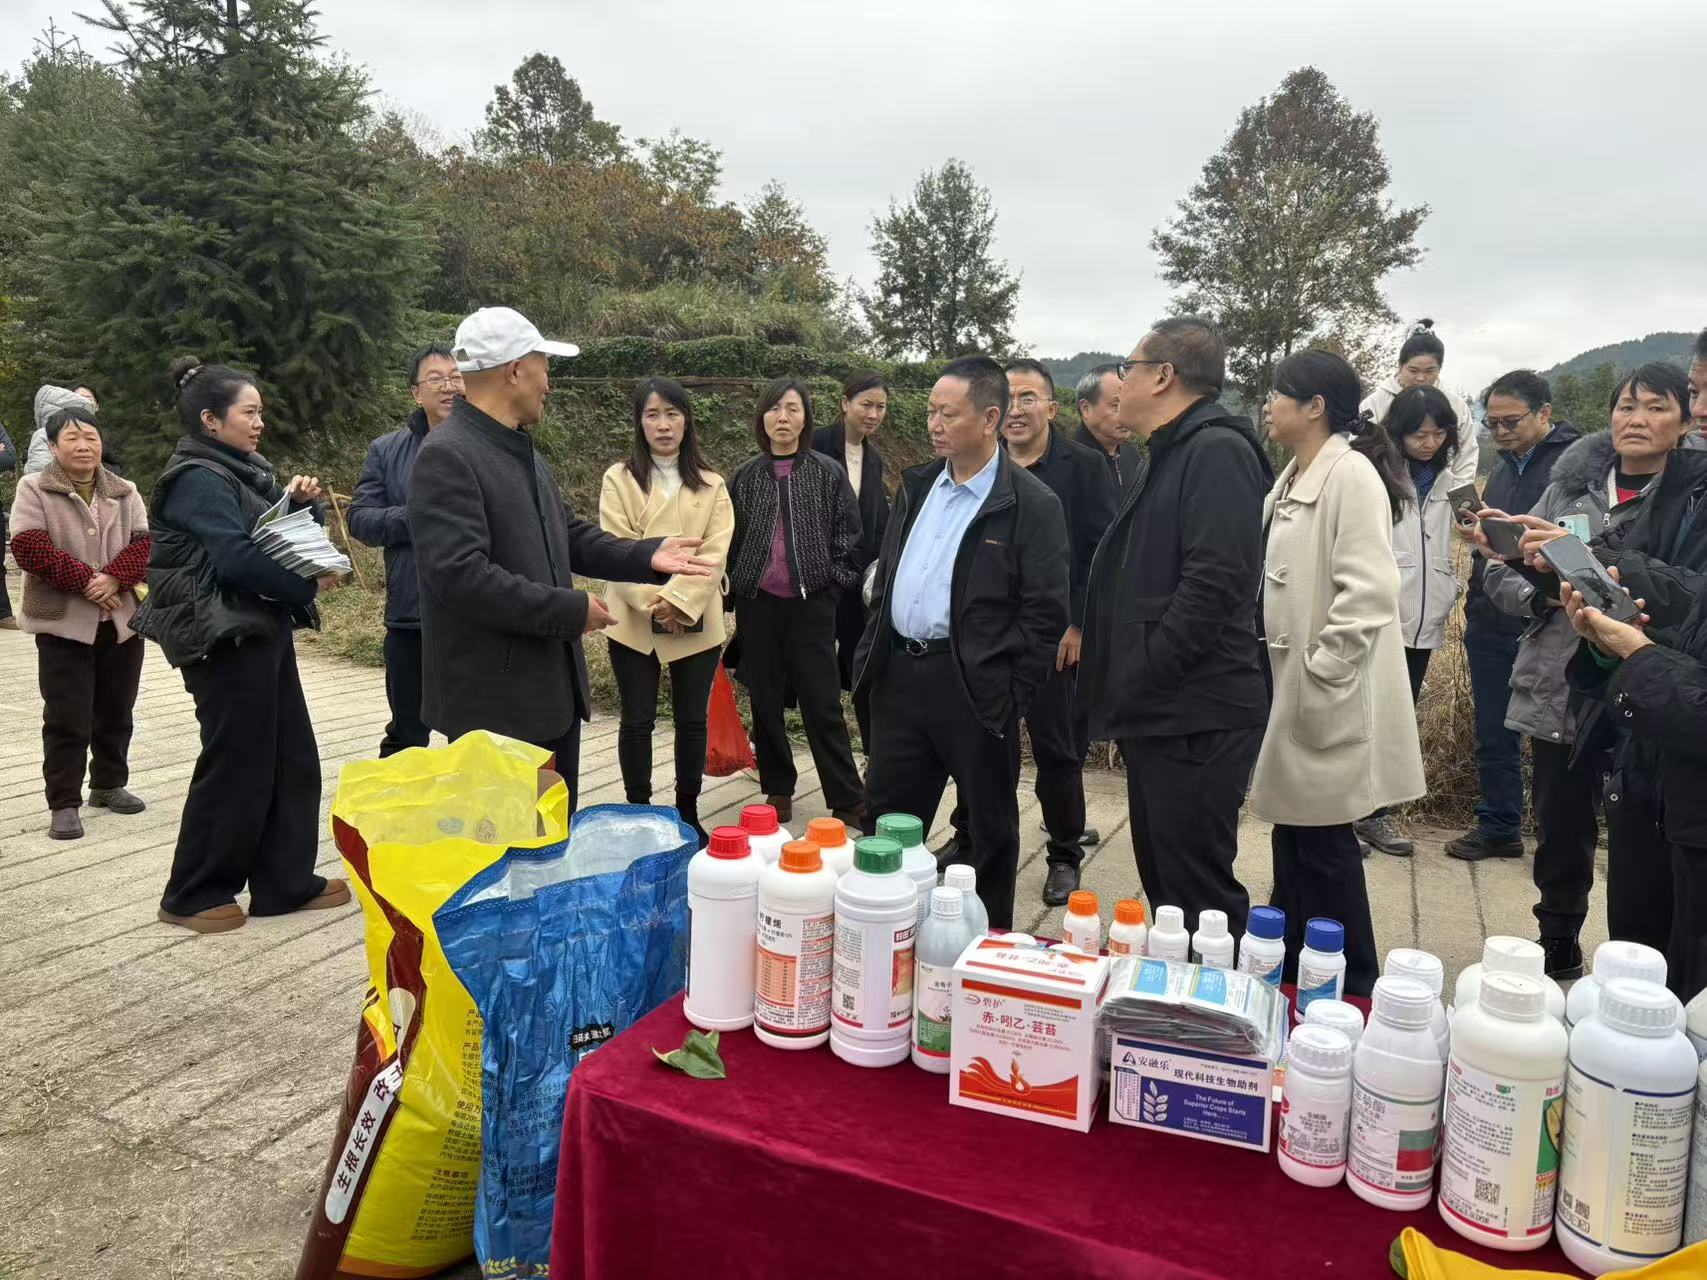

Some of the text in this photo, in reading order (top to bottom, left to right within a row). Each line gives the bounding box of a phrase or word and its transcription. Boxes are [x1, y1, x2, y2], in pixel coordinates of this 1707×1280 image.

[982, 1011, 1057, 1036] 赤·吲乙·芸苔
[1138, 1056, 1170, 1071] 安融乐
[1173, 1068, 1259, 1092] 现代科技生物助剂
[1207, 1096, 1227, 1105] Future
[336, 1110, 377, 1195] 生根长效
